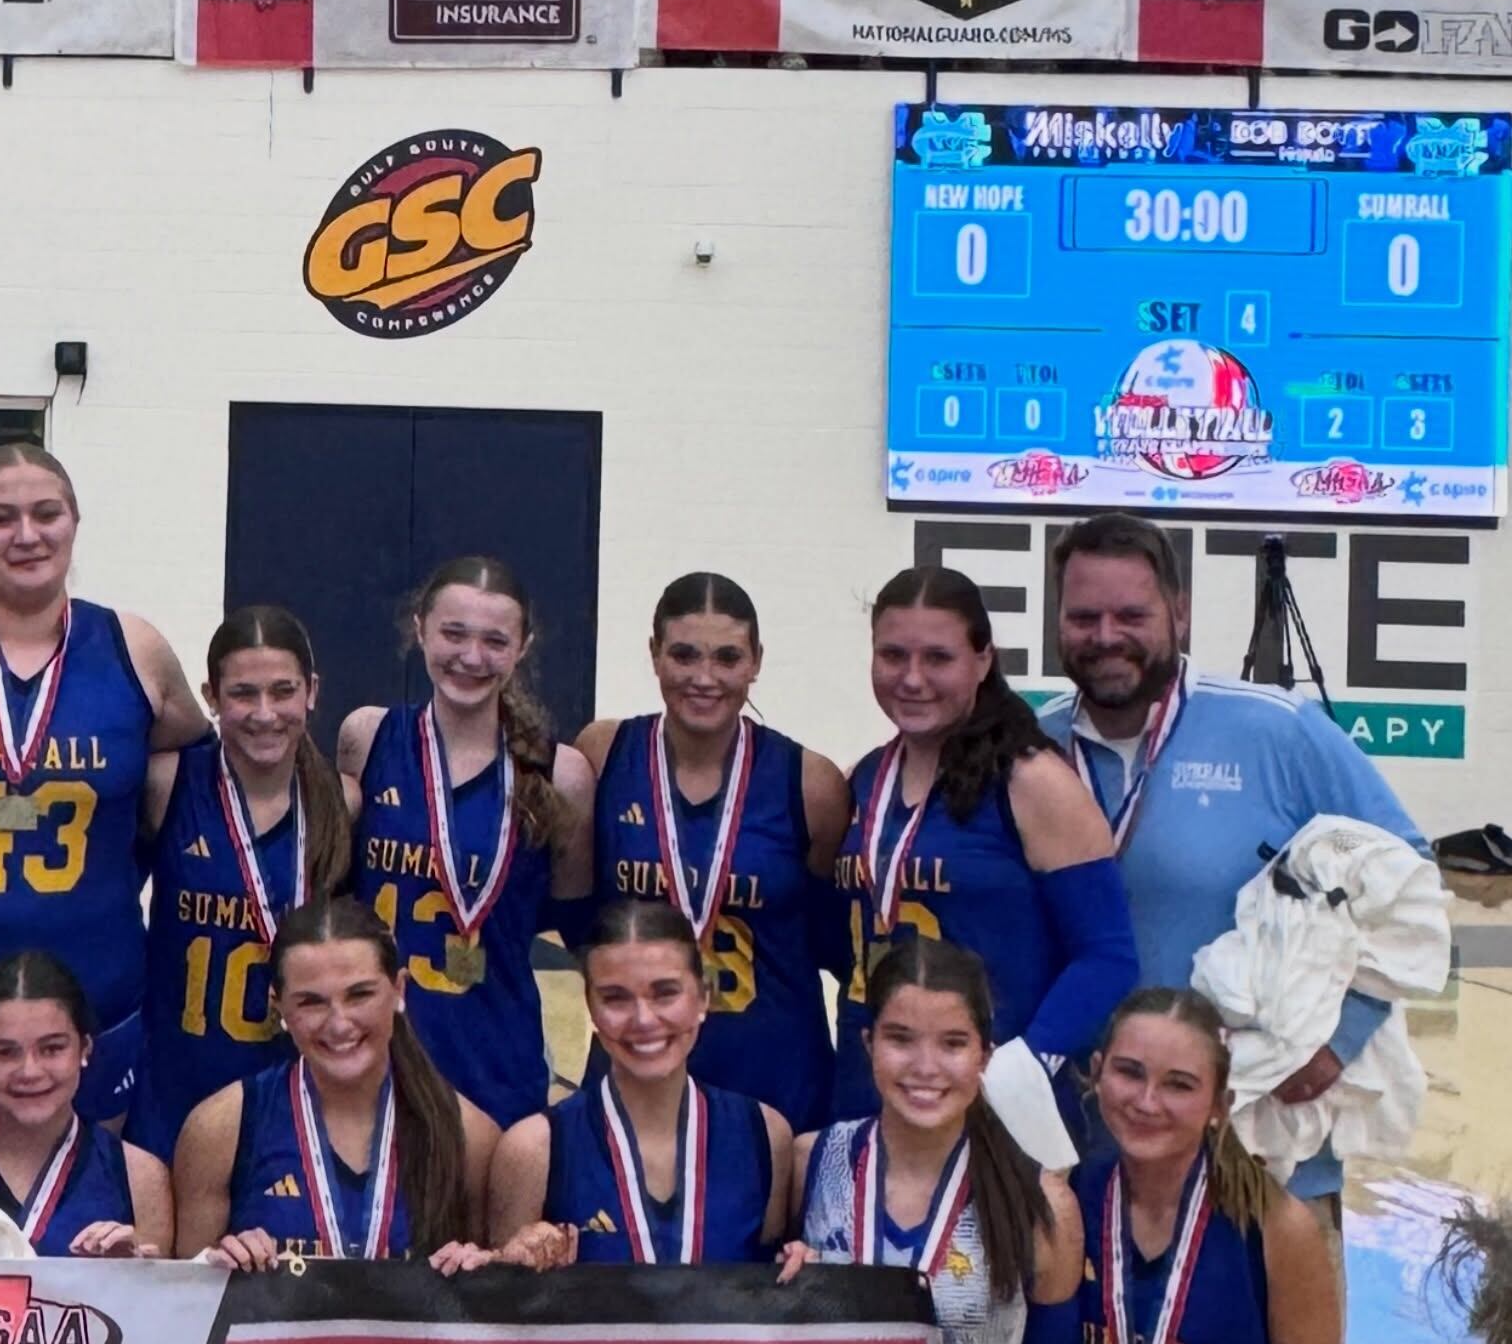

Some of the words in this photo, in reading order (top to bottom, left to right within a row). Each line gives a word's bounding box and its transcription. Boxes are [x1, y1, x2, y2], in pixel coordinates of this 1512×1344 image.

[436, 3, 561, 25] INSURANCE
[924, 184, 970, 210] NEW
[973, 184, 1025, 211] HOPE
[1357, 193, 1450, 221] SUMRALL
[306, 150, 539, 298] GSC
[1124, 188, 1248, 243] 30:00
[955, 222, 988, 286] 0
[1387, 233, 1420, 297] 0
[1144, 300, 1201, 333] SET
[1240, 303, 1257, 336] 4
[943, 395, 961, 428] 0
[1024, 398, 1042, 431] 0
[1326, 407, 1344, 440] 2
[1409, 408, 1427, 441] 3
[913, 519, 1471, 692] ETE
[181, 935, 284, 1043] 10
